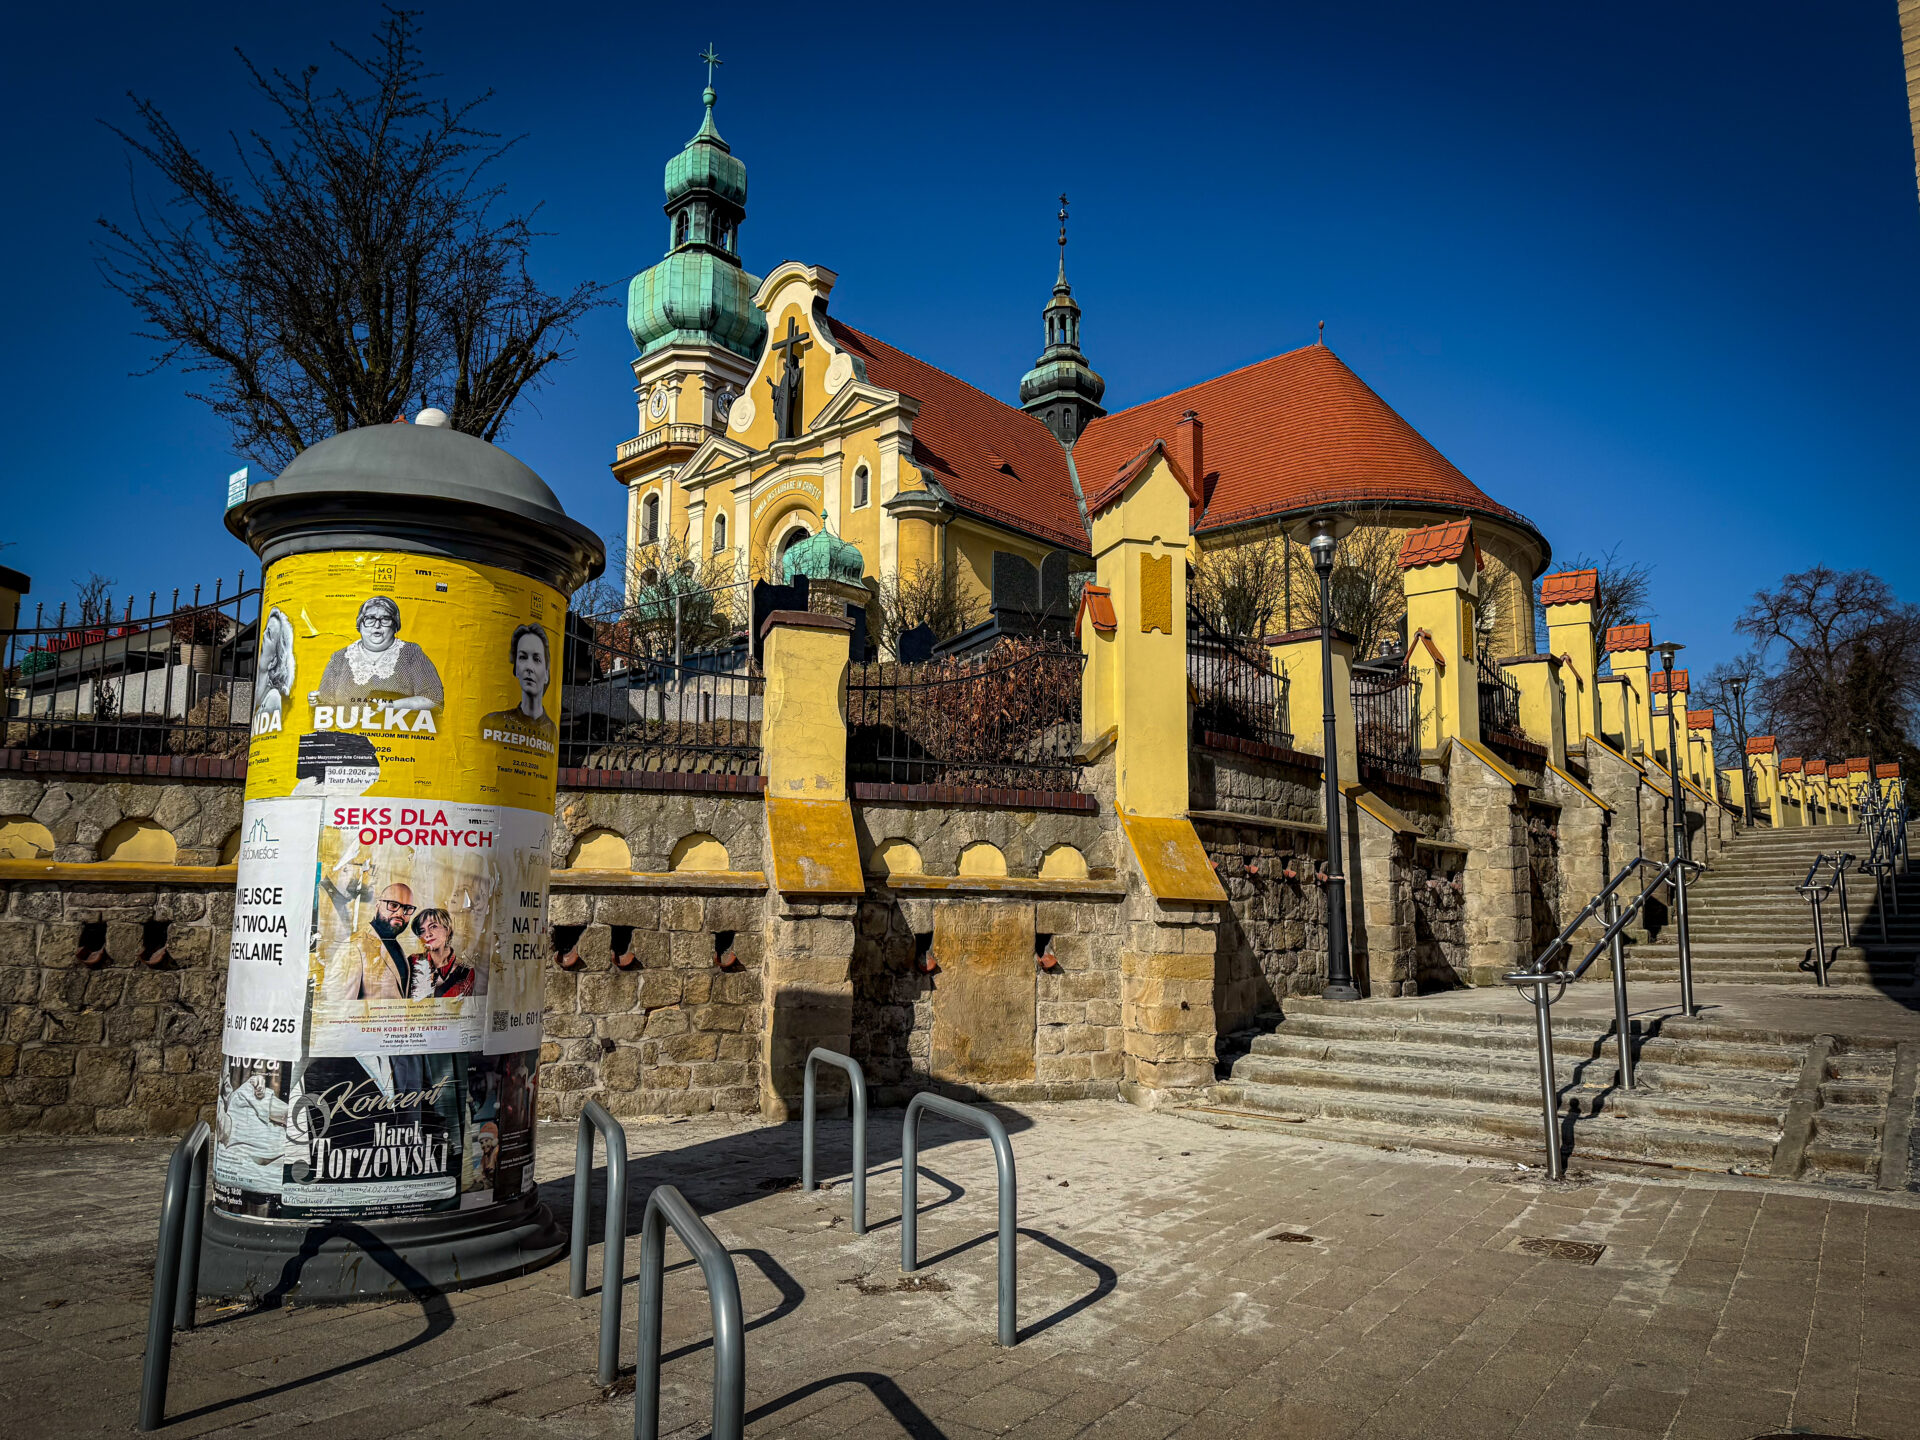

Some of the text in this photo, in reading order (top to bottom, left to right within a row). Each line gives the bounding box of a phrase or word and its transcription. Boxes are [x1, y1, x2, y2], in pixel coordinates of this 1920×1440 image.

[313, 706, 437, 733] BUŁKA
[483, 728, 555, 754] PRZEPIÓRSKA
[380, 755, 416, 763] Tychach
[333, 807, 448, 827] SEKS DLA
[358, 827, 493, 848] OPORNYCH
[237, 887, 283, 905] MIEJSCE
[242, 915, 288, 938] TWOJĄ
[512, 917, 530, 934] NA
[231, 942, 283, 966] REKLAMĘ
[235, 1015, 247, 1031] 601
[250, 1016, 269, 1032] 624
[271, 1018, 296, 1034] 255
[361, 1025, 382, 1033] DZIEŃ
[510, 1014, 524, 1028] tel.
[317, 1075, 462, 1119] Koncert
[373, 1120, 423, 1147] Marek
[312, 1132, 449, 1179] Torzewski
